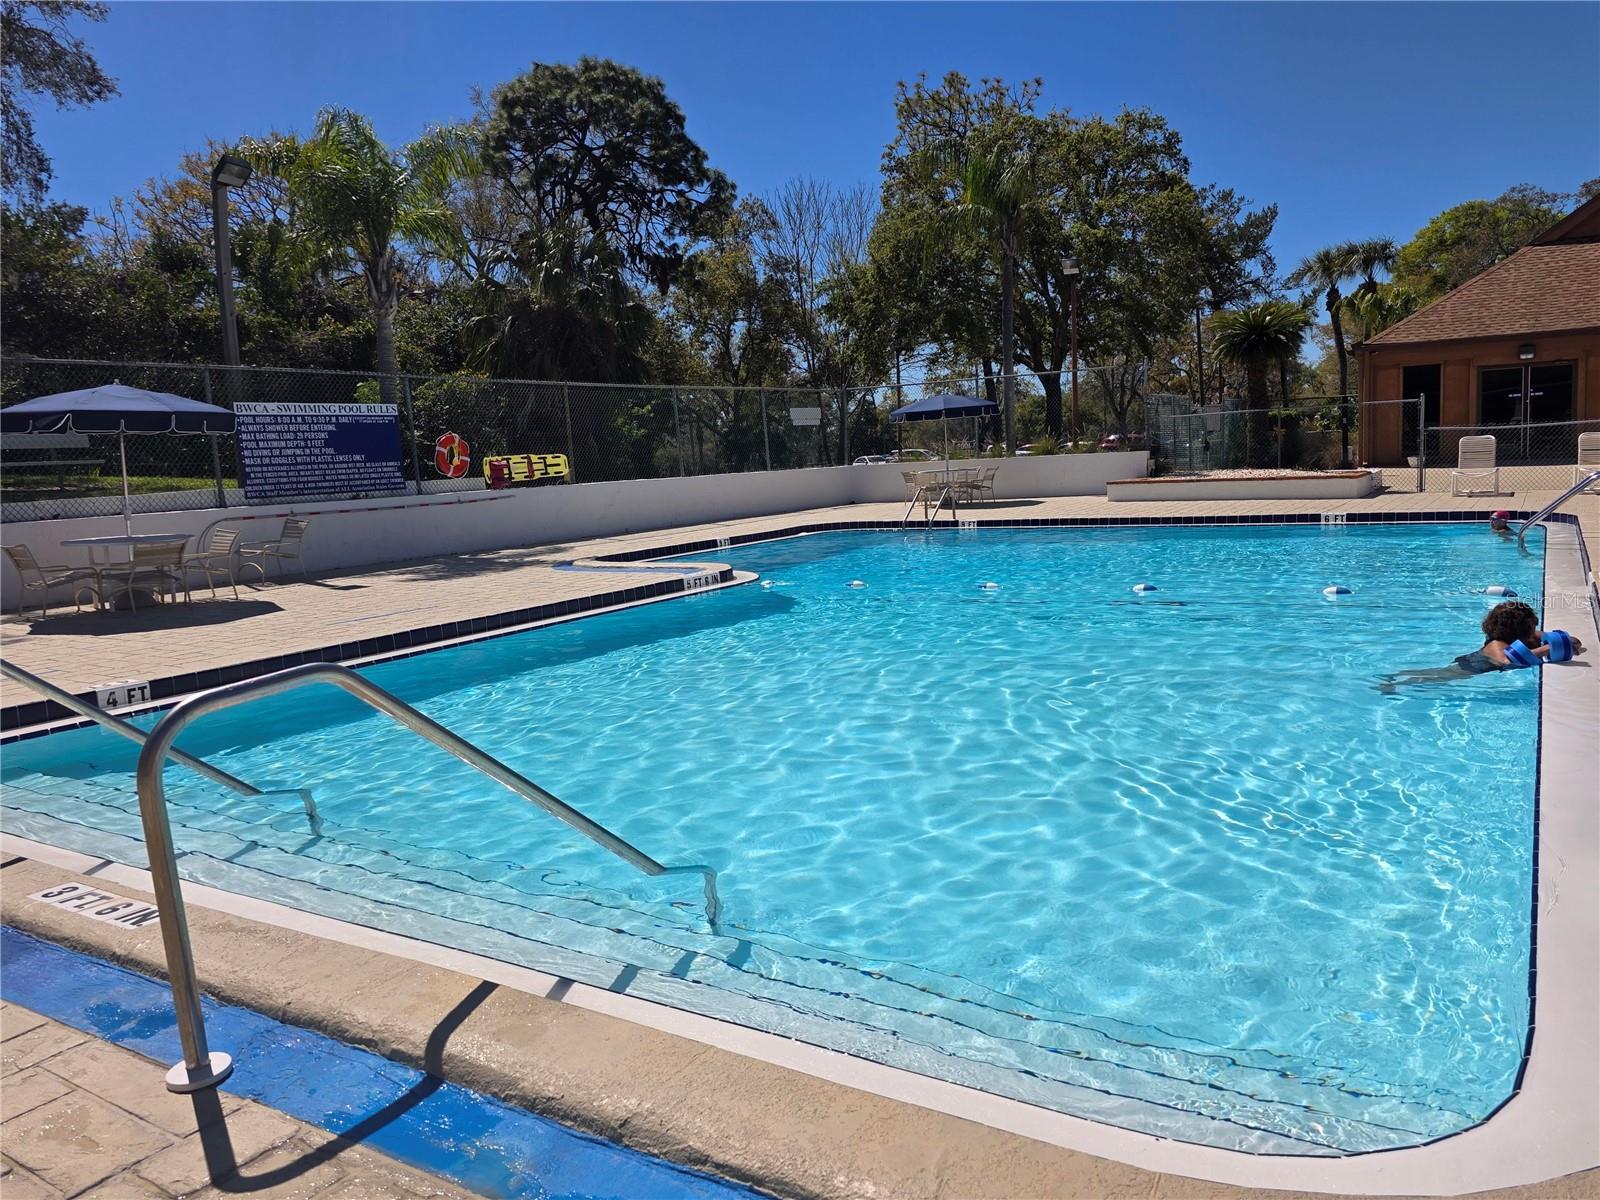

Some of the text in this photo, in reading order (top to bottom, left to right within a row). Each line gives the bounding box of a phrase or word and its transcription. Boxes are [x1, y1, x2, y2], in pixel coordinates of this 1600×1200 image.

[236, 404, 269, 413] BWCA
[276, 404, 336, 414] SWIMMING
[338, 404, 366, 414] POOL
[366, 405, 397, 414] RULES
[1335, 514, 1344, 522] FT
[686, 580, 691, 588] 5
[694, 578, 702, 588] FT
[712, 574, 719, 584] IN
[107, 691, 118, 706] 4
[41, 886, 79, 898] 3
[95, 902, 133, 916] 6
